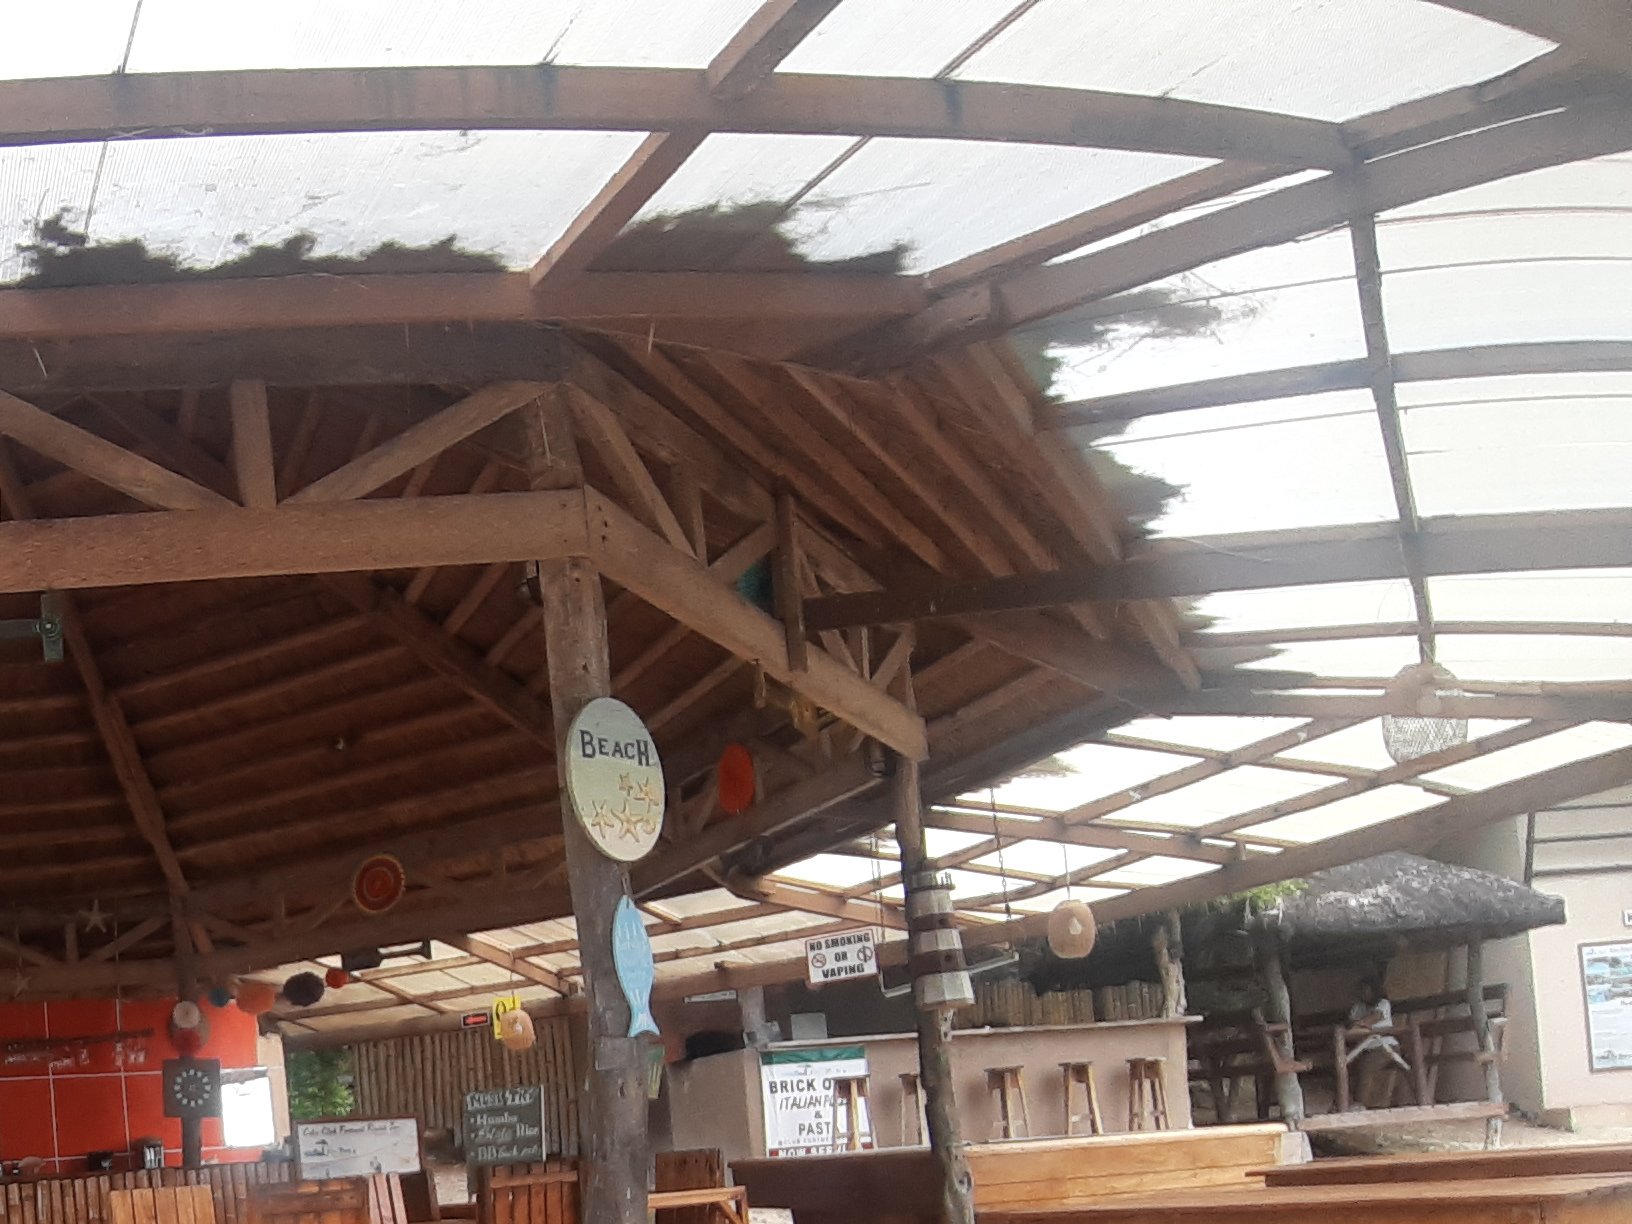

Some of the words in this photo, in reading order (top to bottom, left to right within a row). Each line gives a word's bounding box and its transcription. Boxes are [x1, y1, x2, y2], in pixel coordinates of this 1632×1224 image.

[809, 940, 822, 951] NO
[824, 932, 870, 949] SMOKING
[834, 951, 848, 962] OR
[821, 963, 865, 978] VAPING
[769, 1078, 816, 1094] BRICK
[779, 1092, 822, 1110] ITALIAN
[814, 1110, 823, 1119] &
[798, 1121, 831, 1136] PAST
